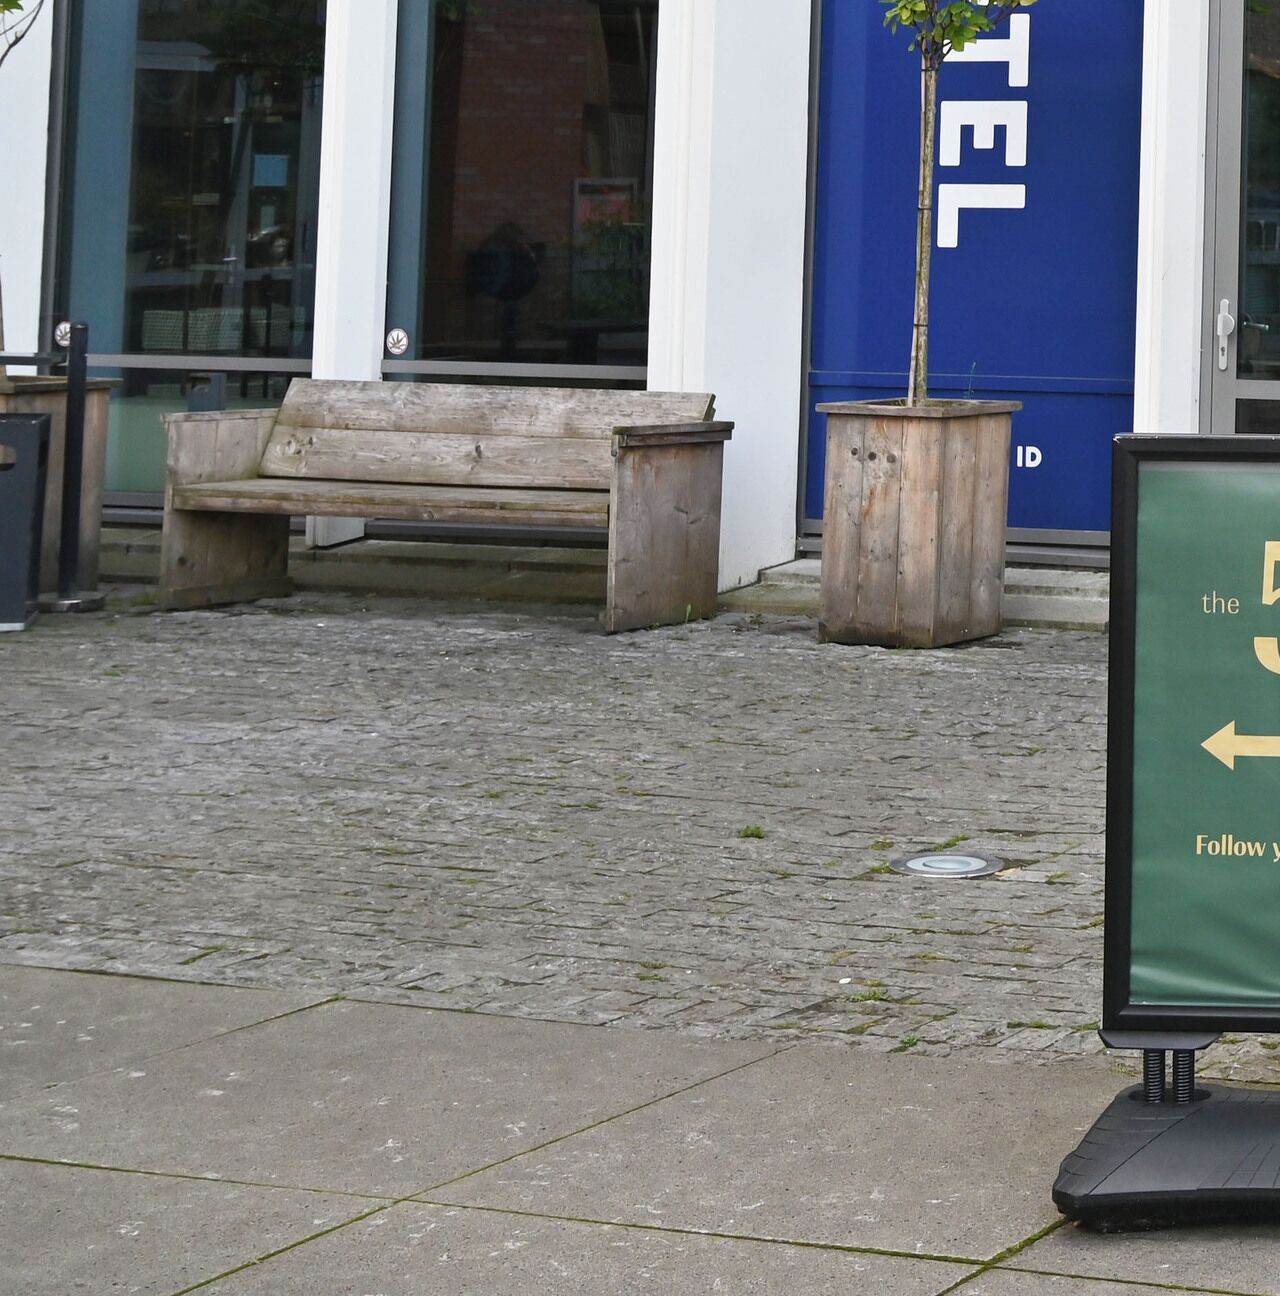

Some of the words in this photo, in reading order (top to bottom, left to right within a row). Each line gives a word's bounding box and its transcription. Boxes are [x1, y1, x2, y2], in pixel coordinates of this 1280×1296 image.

[1017, 445, 1043, 468] ID
[1202, 590, 1241, 615] the
[1195, 834, 1265, 858] Follow
